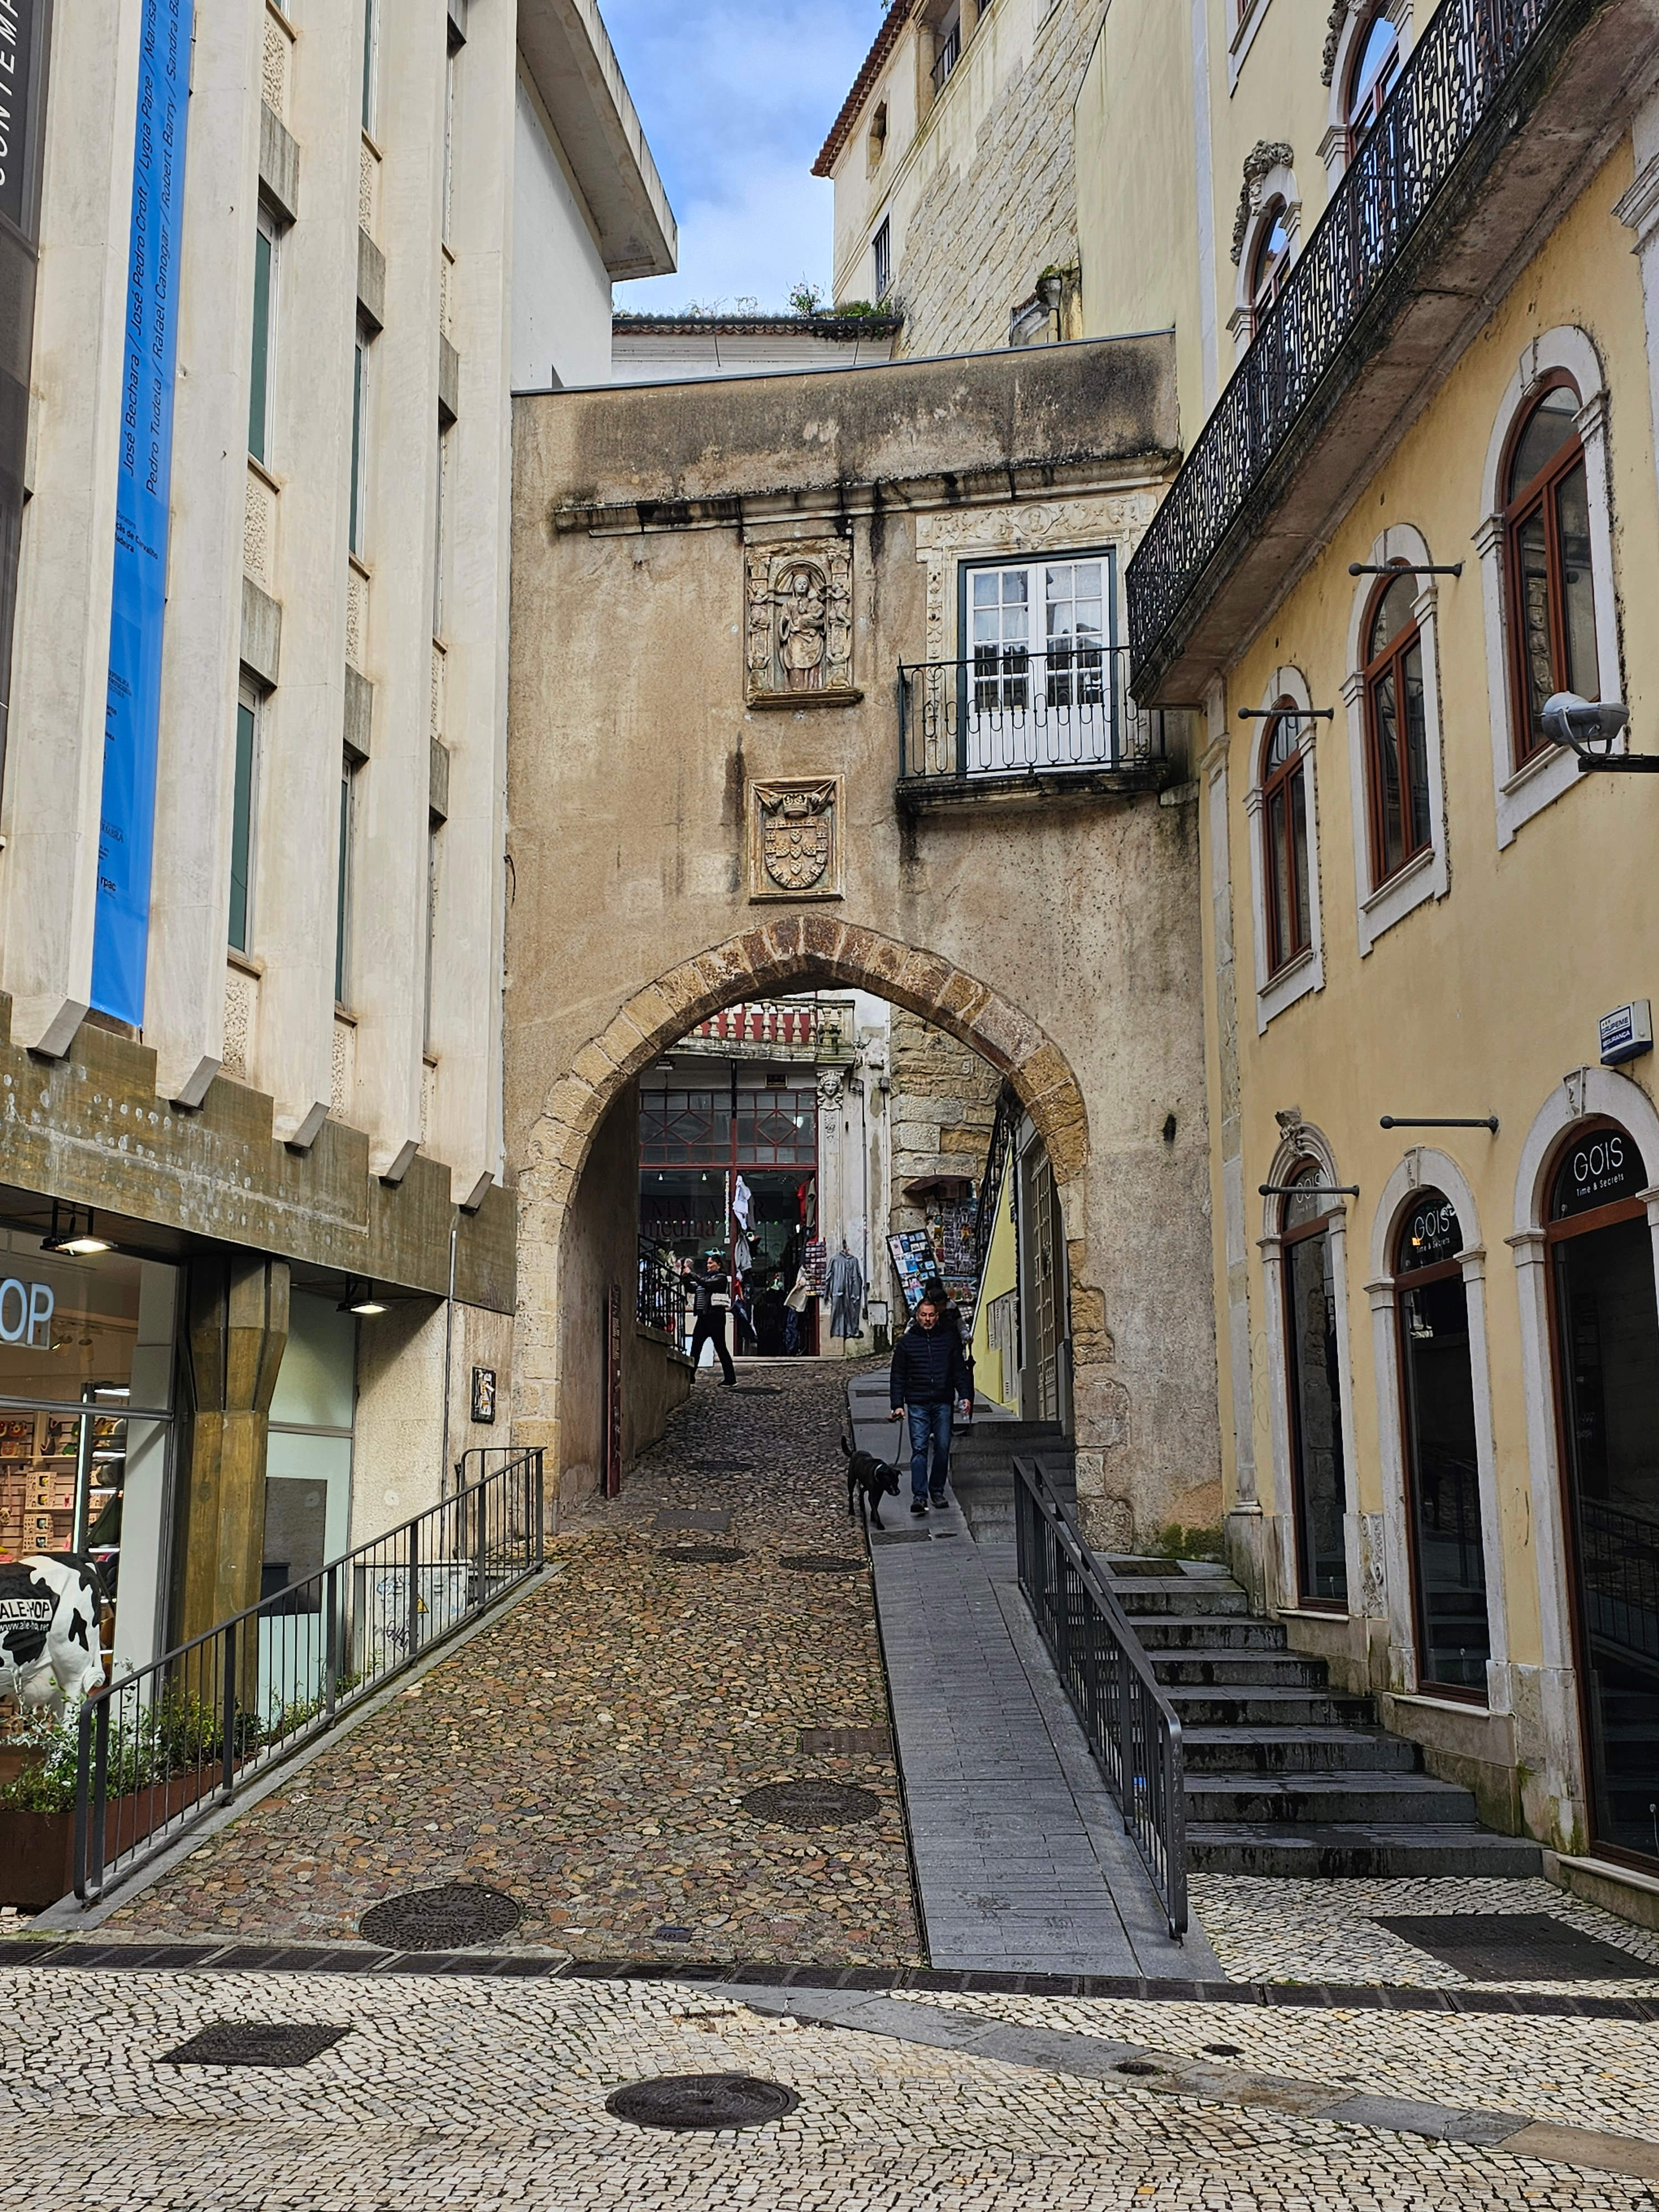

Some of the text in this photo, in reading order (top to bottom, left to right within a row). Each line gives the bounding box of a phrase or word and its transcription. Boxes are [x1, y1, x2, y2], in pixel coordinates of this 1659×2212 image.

[144, 0, 157, 59] Marisa
[166, 20, 178, 81] Sandra
[141, 75, 154, 121] Pape
[163, 97, 177, 148] Barry
[139, 122, 153, 170] Lygia
[161, 149, 173, 209] Robert
[135, 185, 148, 232] Croft
[133, 235, 145, 289] Pedro
[155, 225, 170, 300] Canogar
[131, 290, 143, 336] José
[153, 301, 165, 359] Rafael
[126, 354, 139, 429] Bechara
[150, 378, 162, 436] Tudela
[123, 431, 135, 477] José
[146, 441, 159, 496] Pedro
[1574, 1137, 1623, 1181] GÓIS
[1577, 1186, 1591, 1196] Time
[1599, 1173, 1624, 1188] Secrets
[1415, 1207, 1449, 1241] GÓIS
